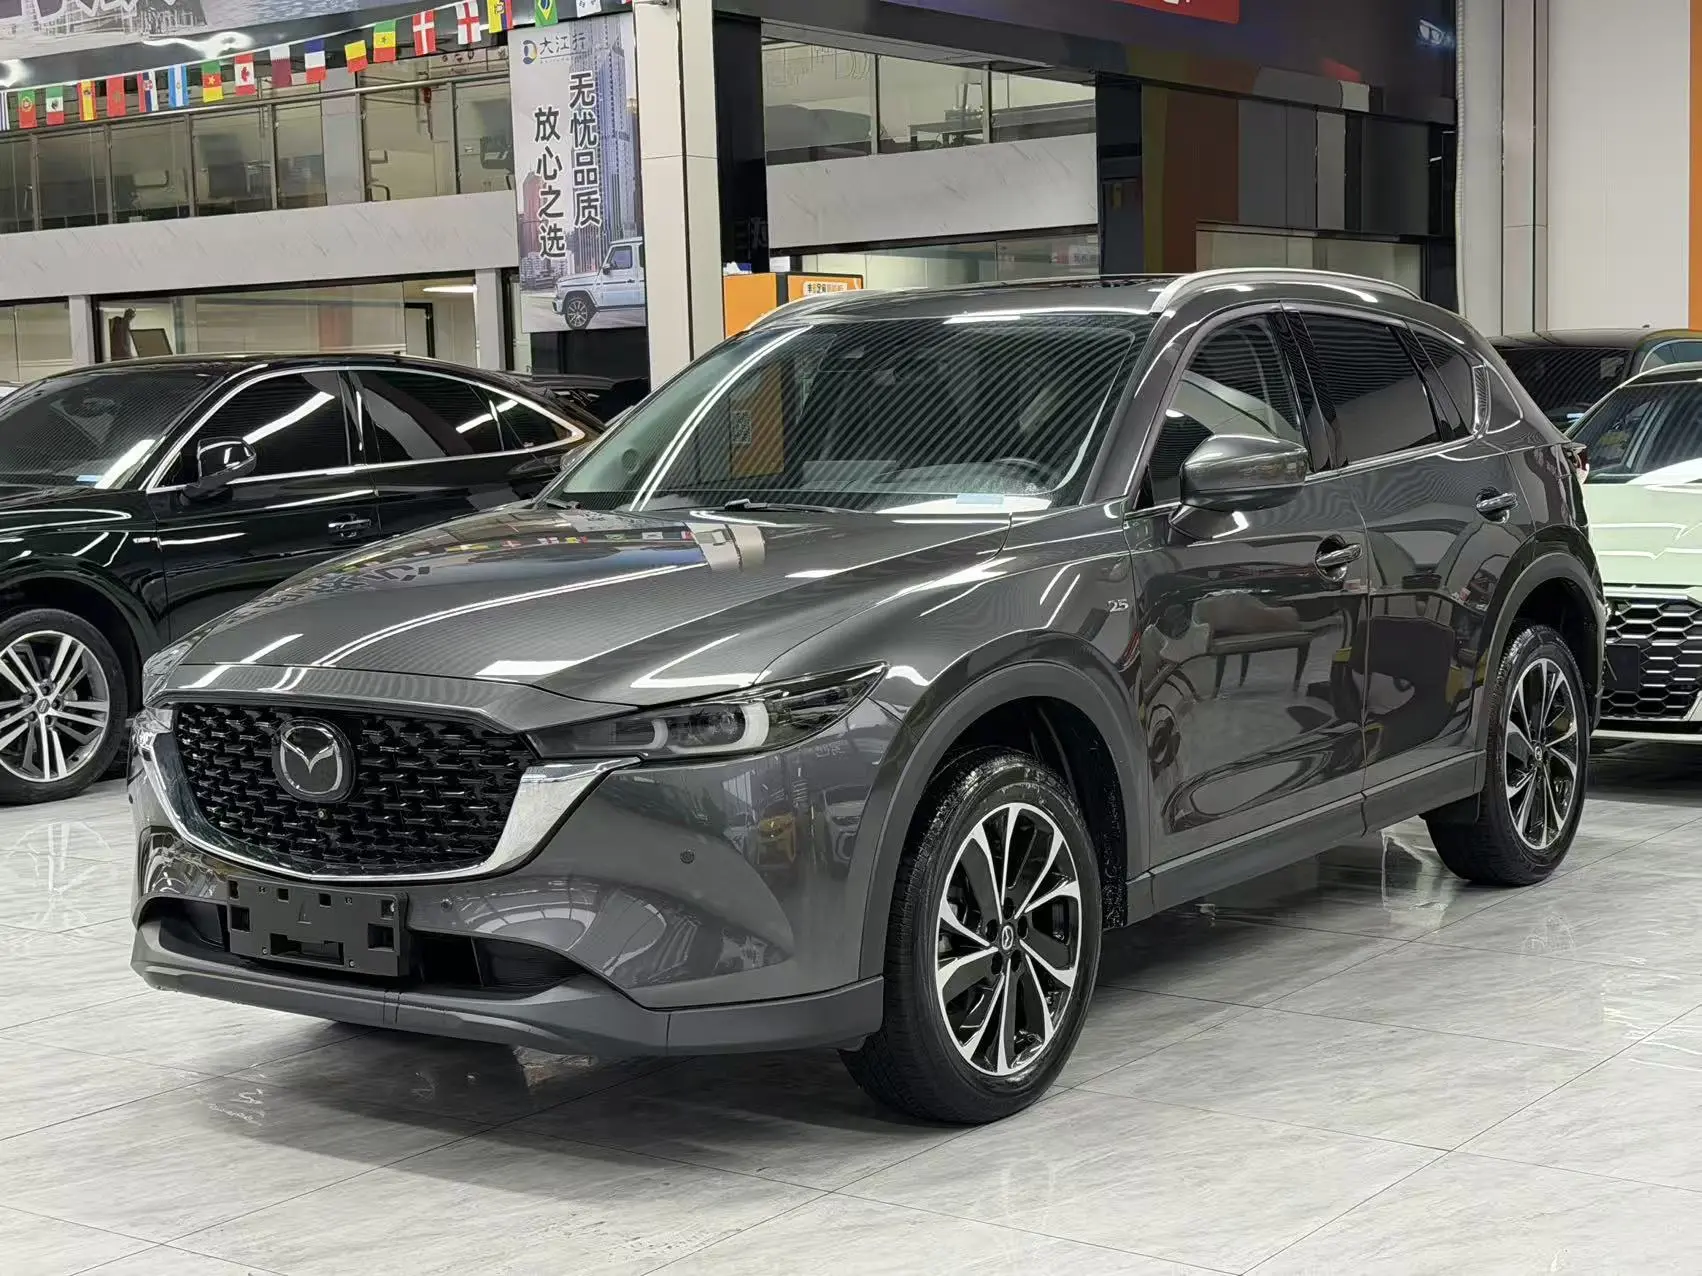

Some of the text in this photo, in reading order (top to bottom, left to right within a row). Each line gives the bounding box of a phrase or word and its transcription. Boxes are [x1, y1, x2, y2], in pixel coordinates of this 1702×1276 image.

[540, 32, 586, 55] 大江行
[534, 106, 566, 260] 放心之选
[569, 71, 601, 228] 无忧品质
